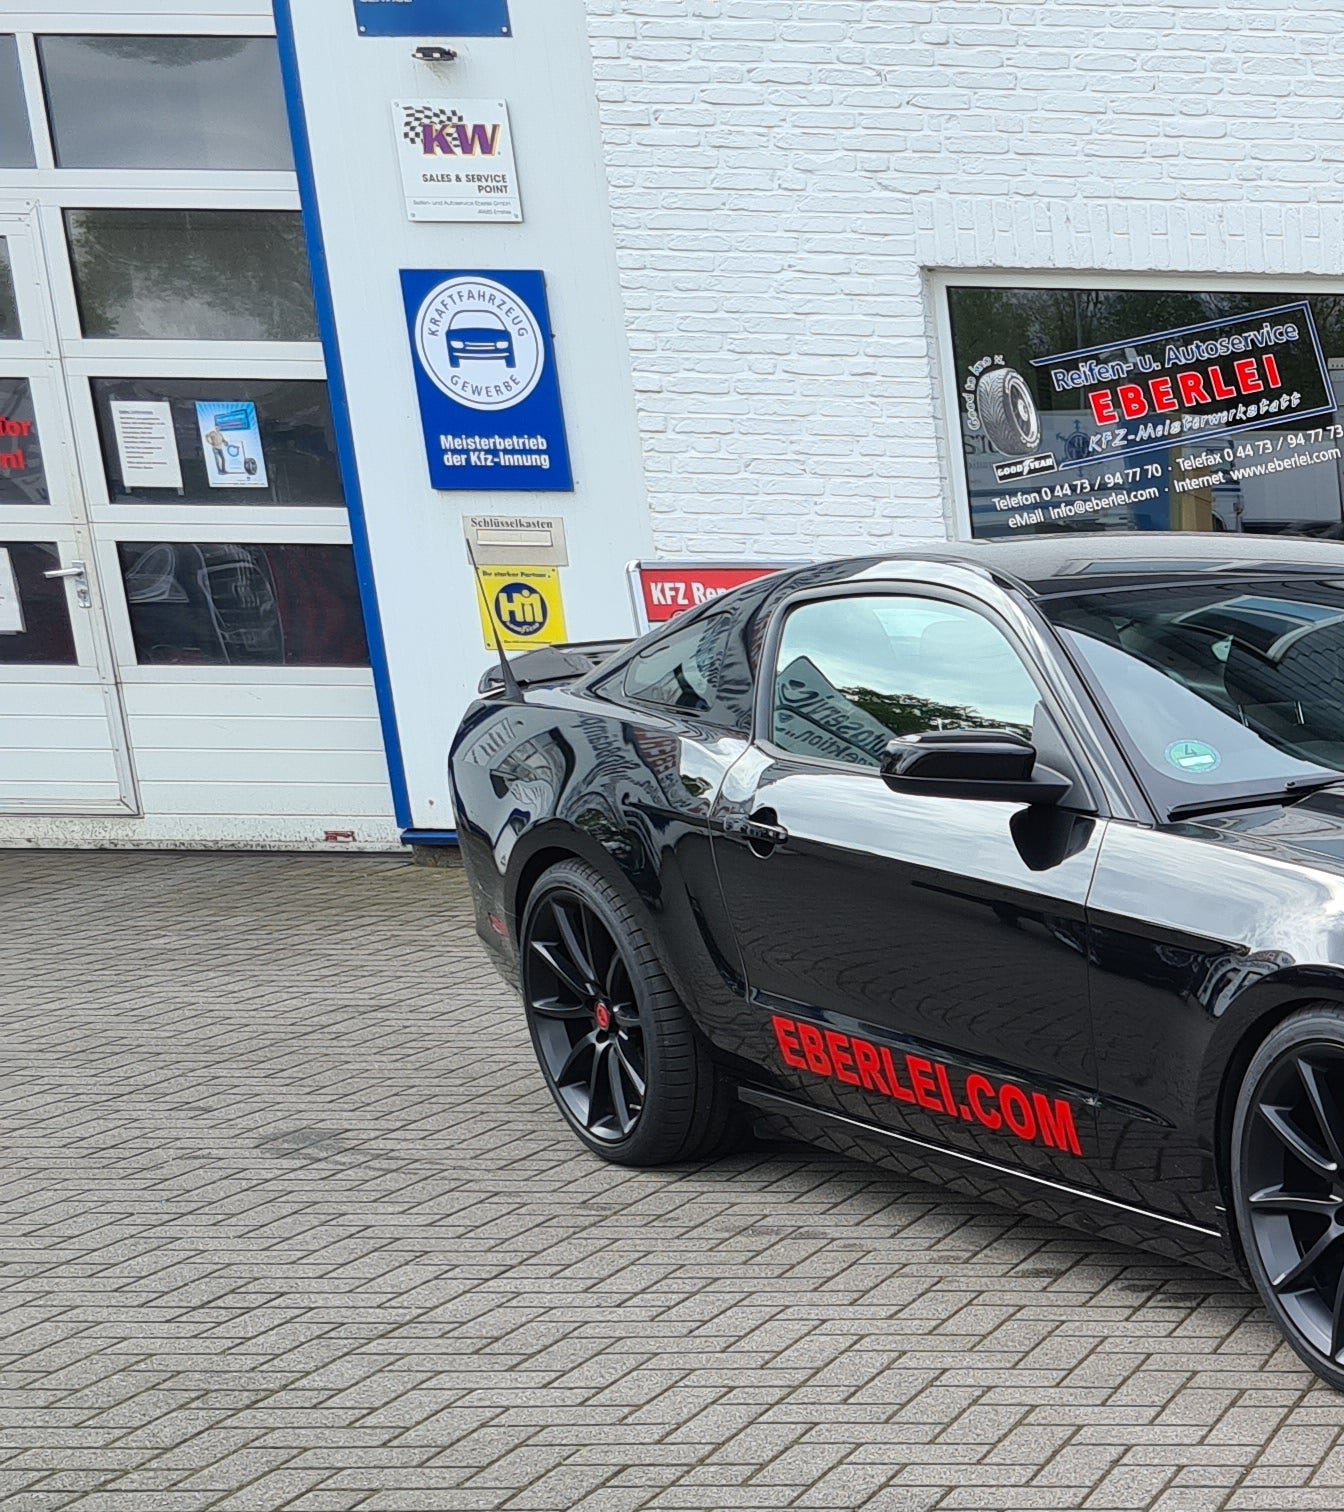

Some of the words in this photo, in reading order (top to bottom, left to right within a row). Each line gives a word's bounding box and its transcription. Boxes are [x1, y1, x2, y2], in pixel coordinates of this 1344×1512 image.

[422, 123, 500, 156] KW
[422, 173, 452, 183] SALES
[455, 174, 462, 183] &
[465, 174, 508, 183] SERVICE
[477, 185, 508, 194] POINT
[427, 289, 529, 337] KRAFTFAHRZEUG
[1051, 361, 1133, 392] Reifen-
[1136, 354, 1161, 372] u.
[1165, 322, 1299, 368] Autoservice
[450, 373, 521, 398] GEWERBE
[1088, 354, 1282, 426] EBERLEI
[1088, 391, 1302, 452] KFZ-Meisterwerkstatt
[439, 434, 548, 450] Meisterbetrieb
[443, 452, 467, 466] der
[470, 452, 550, 469] Kfz-Innung
[997, 458, 1053, 477] GOODYEAR
[1174, 471, 1226, 493] Internet
[1230, 448, 1342, 481] www.eberlei.com
[992, 492, 1039, 511] Telefon
[1176, 452, 1223, 472] Telefax
[471, 517, 553, 529] Schlüsselkasten
[650, 582, 689, 605] KFZ
[771, 1015, 1083, 1157] EBERLEI.COM
